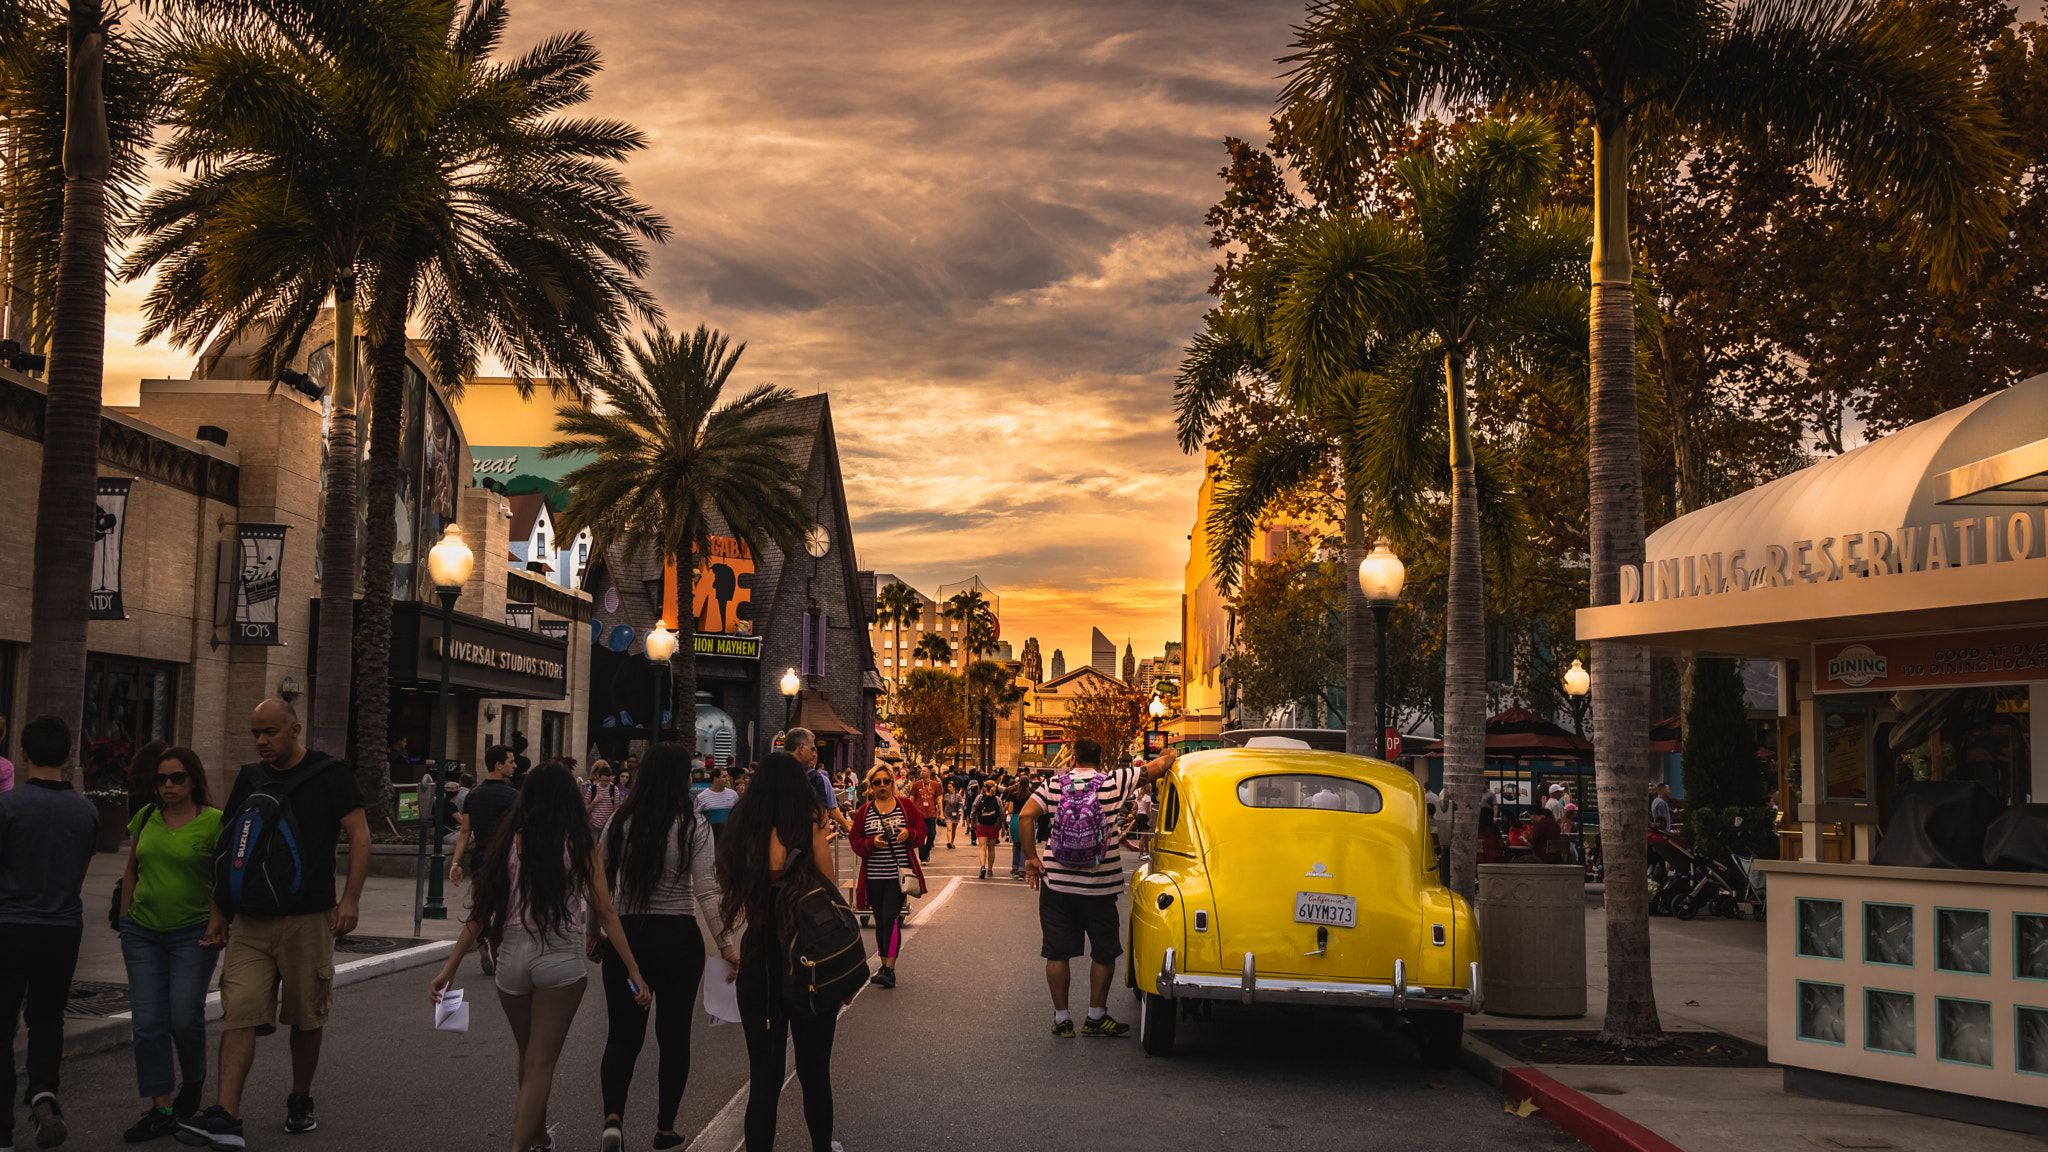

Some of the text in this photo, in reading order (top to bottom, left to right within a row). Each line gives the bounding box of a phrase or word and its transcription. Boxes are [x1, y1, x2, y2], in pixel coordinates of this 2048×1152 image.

[1620, 550, 1750, 604] DINING
[1766, 509, 2048, 587] RESERVATIO
[240, 623, 270, 638] TOYS
[717, 639, 756, 656] MAYHEM
[1934, 648, 1981, 662] GOOD
[1985, 646, 2006, 659] AT
[500, 651, 537, 674] STUDIOS
[540, 660, 564, 679] STORE
[1829, 659, 1886, 675] DINING
[1903, 664, 1925, 677] 100
[1929, 660, 1988, 677] DINING
[237, 819, 251, 858] SUZUKI
[1308, 895, 1344, 905] California
[1299, 903, 1352, 922] 6VYM373
